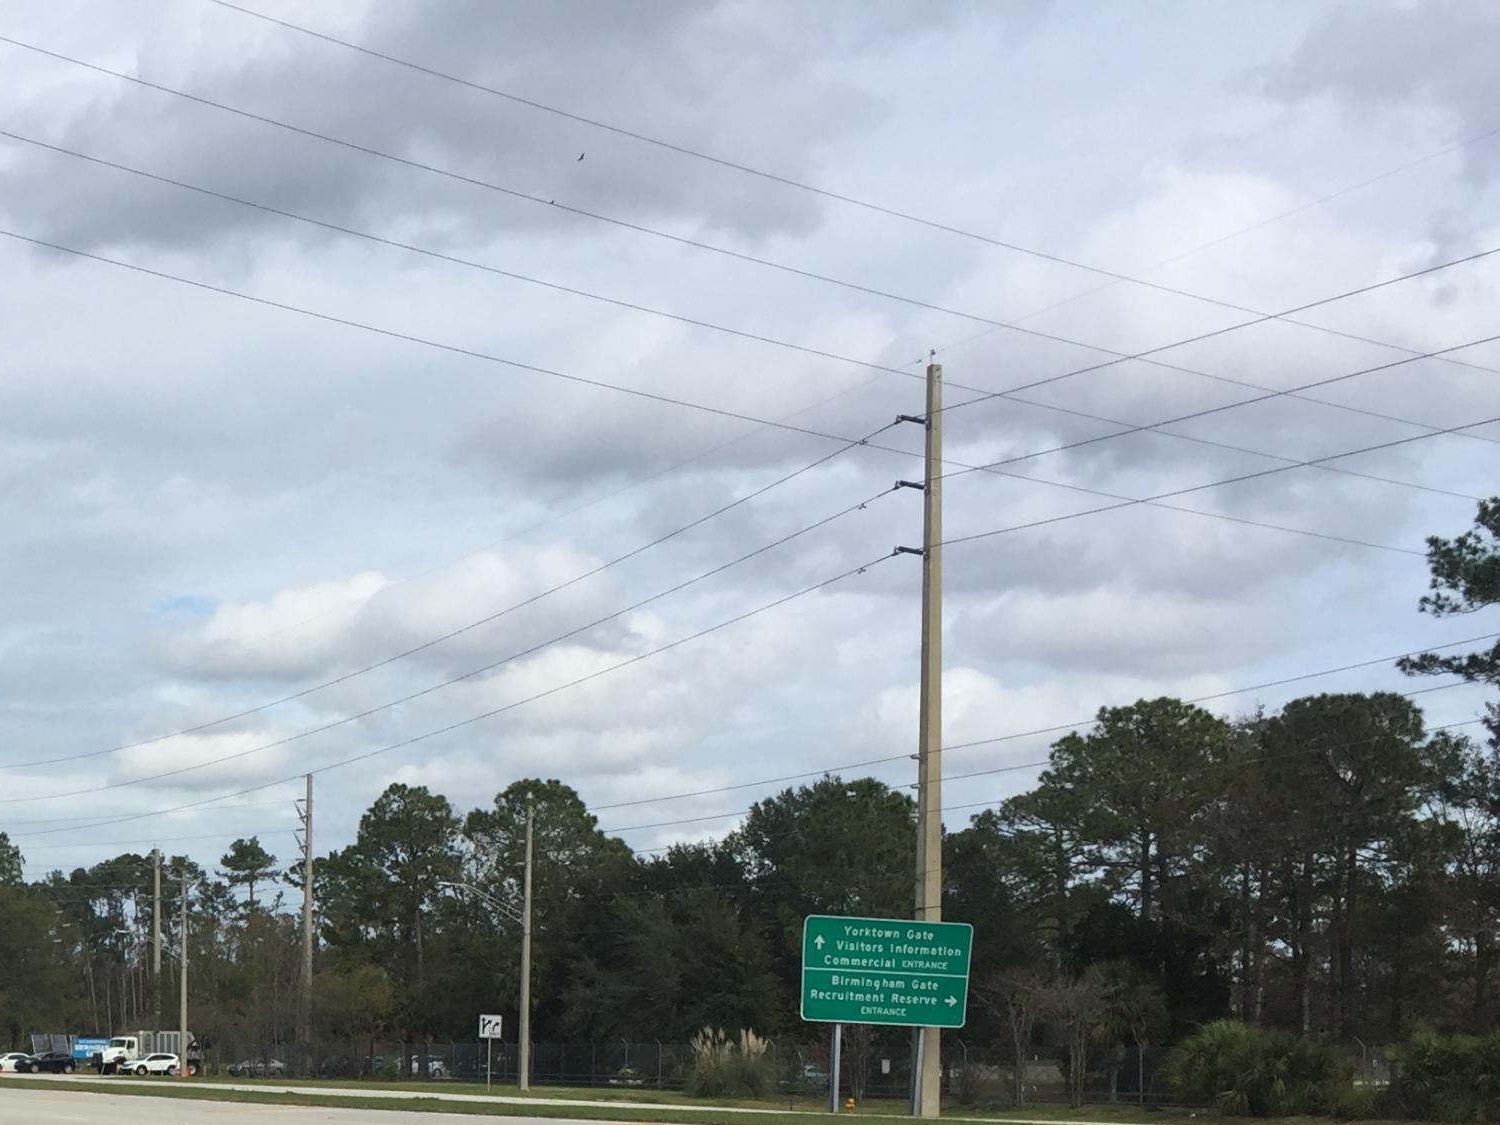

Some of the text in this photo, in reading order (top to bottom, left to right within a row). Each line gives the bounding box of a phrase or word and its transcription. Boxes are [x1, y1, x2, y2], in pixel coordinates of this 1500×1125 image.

[844, 925, 934, 941] Yorktown Gate
[836, 940, 962, 957] Visitors Information
[824, 954, 949, 970] Commercial ENTRANCE
[831, 975, 939, 991] Birmingham Gate
[810, 988, 938, 1006] Recruitment Reserve
[860, 1006, 907, 1017] ENTRANCE
